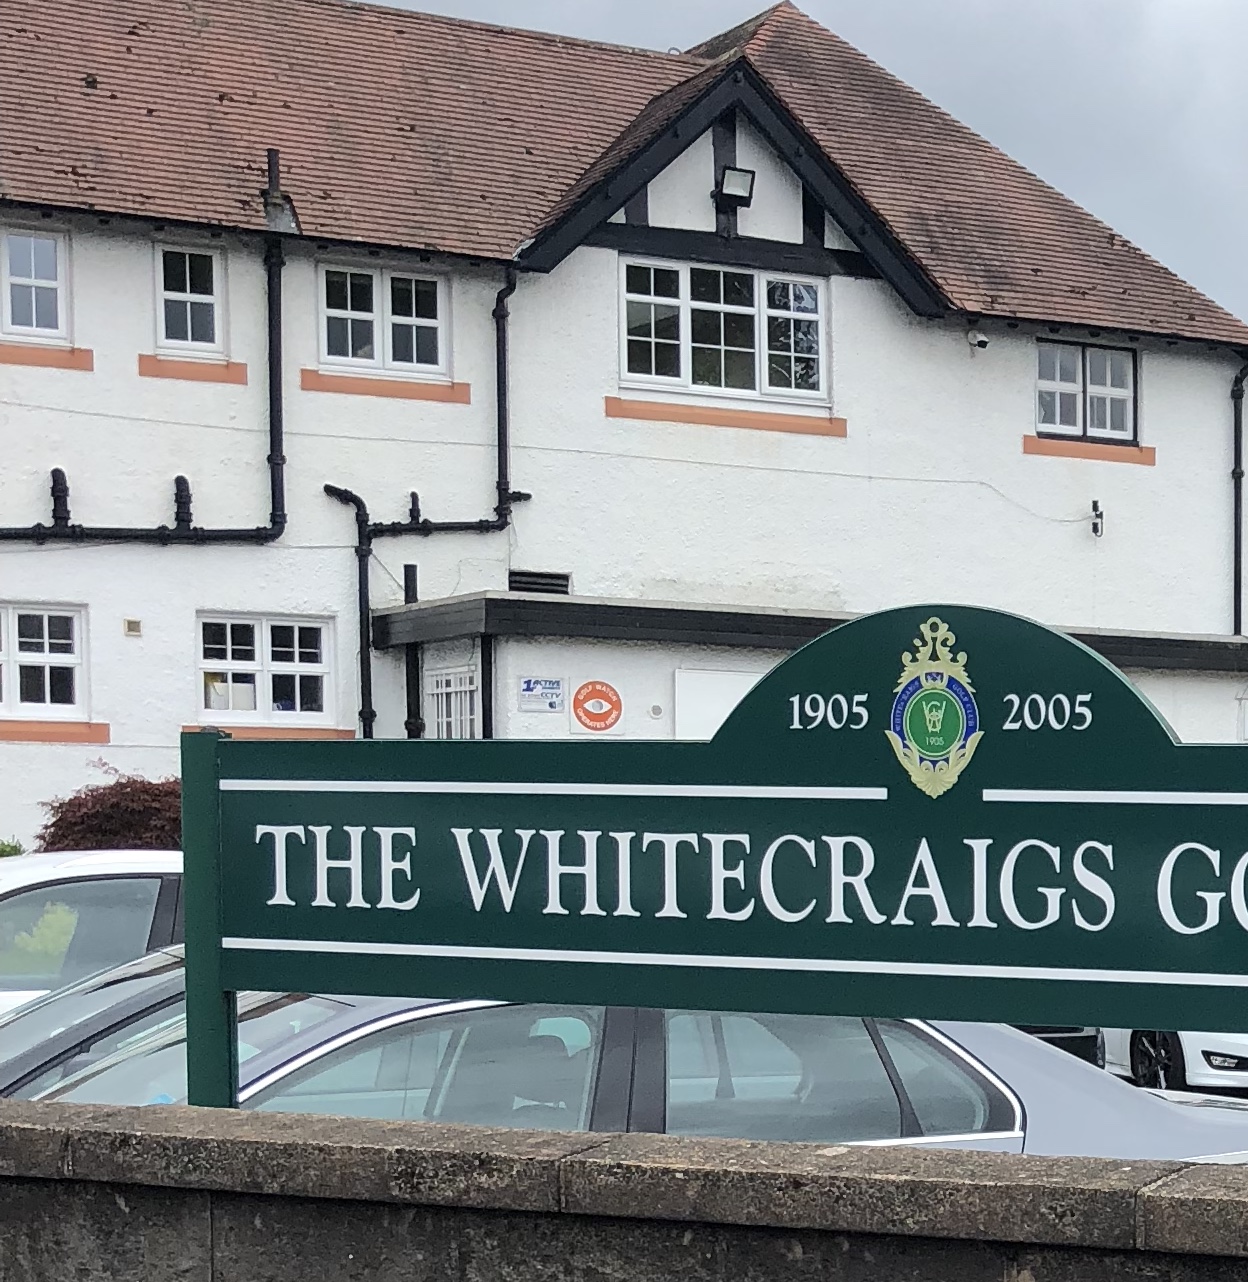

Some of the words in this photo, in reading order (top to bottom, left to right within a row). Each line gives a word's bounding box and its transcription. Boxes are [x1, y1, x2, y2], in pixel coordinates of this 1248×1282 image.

[577, 684, 593, 700] GOLF
[595, 684, 618, 702] WATCH
[789, 693, 869, 730] 1905
[1002, 692, 1093, 731] 2005
[925, 736, 945, 746] 1905
[255, 824, 421, 911] THE
[450, 827, 1116, 932] WHITECRAIGS
